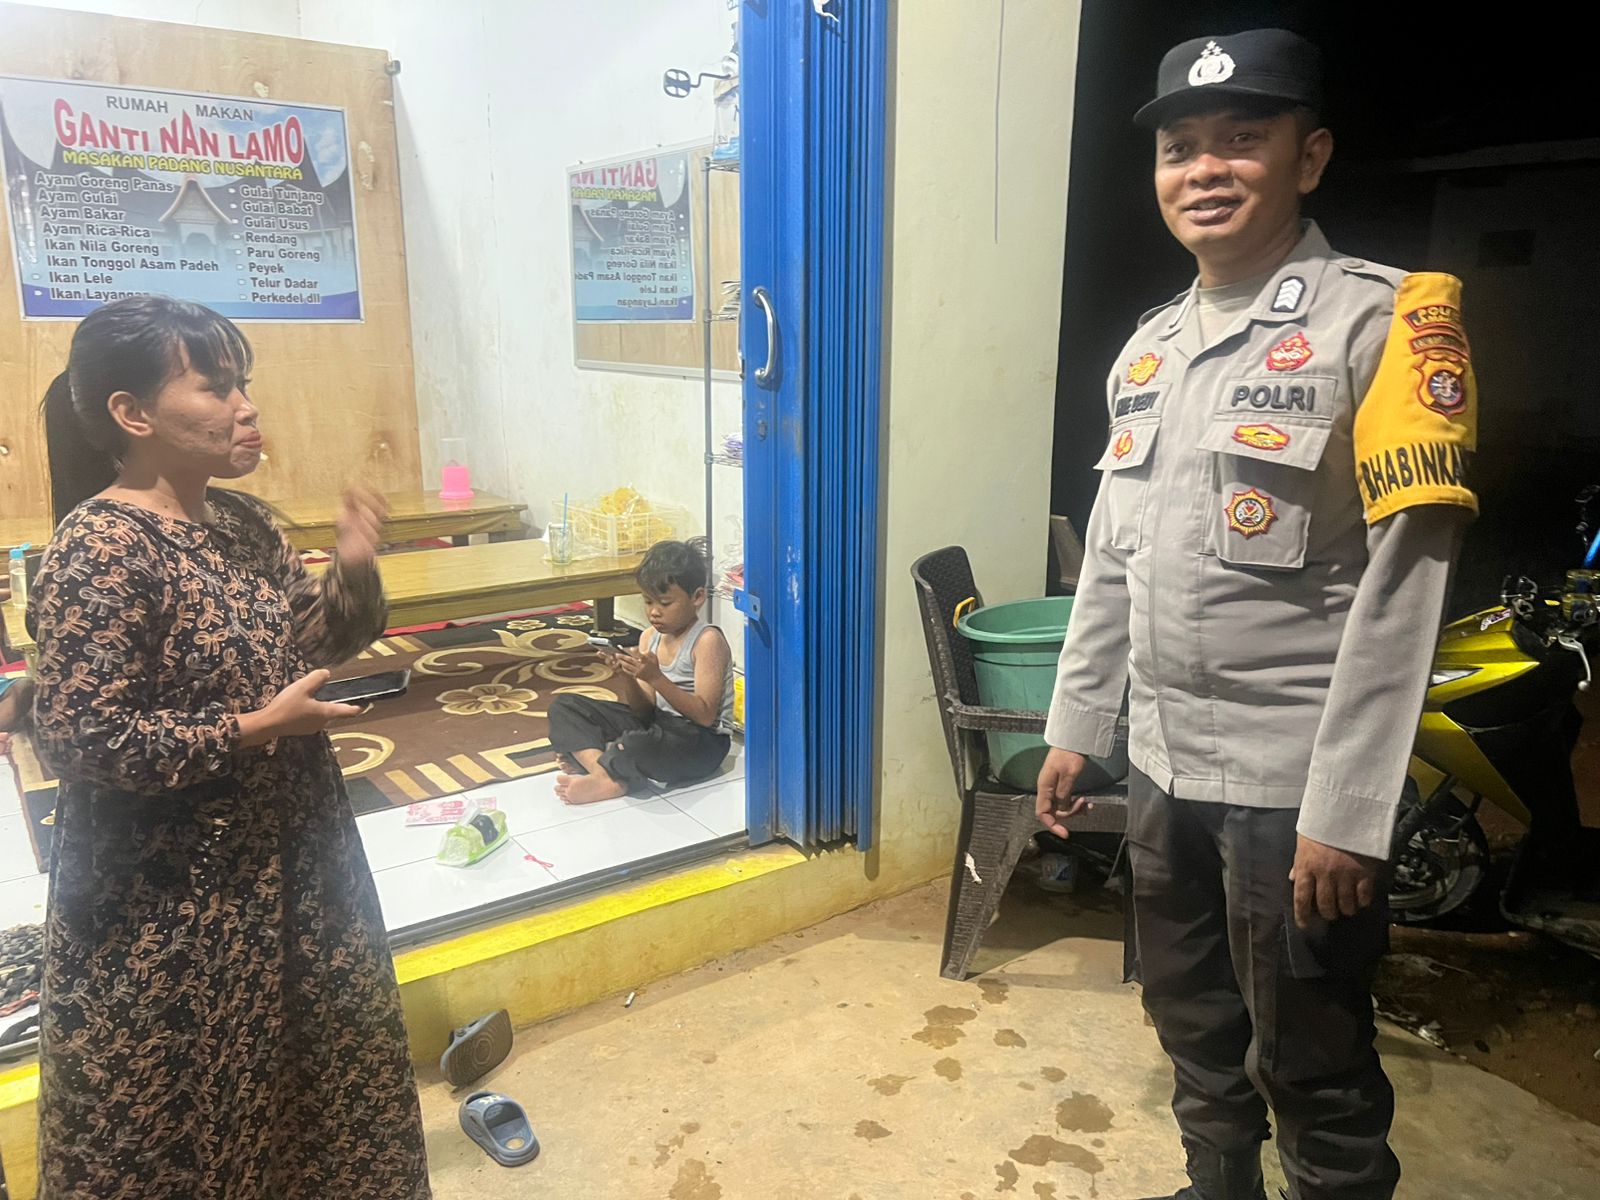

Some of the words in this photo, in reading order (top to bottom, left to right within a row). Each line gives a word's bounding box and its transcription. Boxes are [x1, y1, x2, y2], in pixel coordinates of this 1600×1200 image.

[106, 95, 169, 113] RUMAH
[195, 104, 253, 121] MAKAN
[54, 98, 149, 152] GANTI
[160, 109, 220, 158] NAN
[229, 116, 303, 164] LAMO
[63, 150, 145, 169] MASAKAN
[147, 155, 211, 174] PADANG
[215, 160, 303, 180] NUSANTARA
[36, 174, 75, 187] Ayam
[80, 175, 129, 190] Goreng
[134, 178, 174, 192] Panas
[38, 189, 77, 203] Ayam
[82, 190, 118, 204] Gulai
[241, 186, 273, 197] Gulai
[275, 188, 324, 204] Tunjang
[40, 206, 79, 219] Ayam
[84, 207, 124, 221] Bakar
[243, 201, 274, 213] Gulai
[278, 203, 313, 216] Babat
[42, 222, 81, 237] Ayam
[86, 223, 151, 238] Rica-Rica
[244, 217, 276, 229] Gulai
[279, 218, 309, 230] Usus
[246, 232, 297, 247] Rendang
[45, 239, 75, 251] Ikan
[80, 240, 107, 252] Nila
[111, 241, 160, 256] Goreng
[247, 247, 275, 258] Paru
[278, 249, 320, 262] Goreng
[47, 255, 78, 267] Ikan
[81, 256, 135, 271] Tonggol
[140, 258, 176, 270] Asam
[180, 260, 219, 272] Padeh
[249, 262, 285, 275] Peyek
[49, 271, 80, 283] Ikan
[84, 272, 113, 284] Lele
[251, 277, 281, 288] Telur
[285, 278, 319, 289] Dadar
[51, 287, 81, 299] Ikan
[252, 292, 303, 303] Perkedel
[1231, 384, 1316, 412] POLRI
